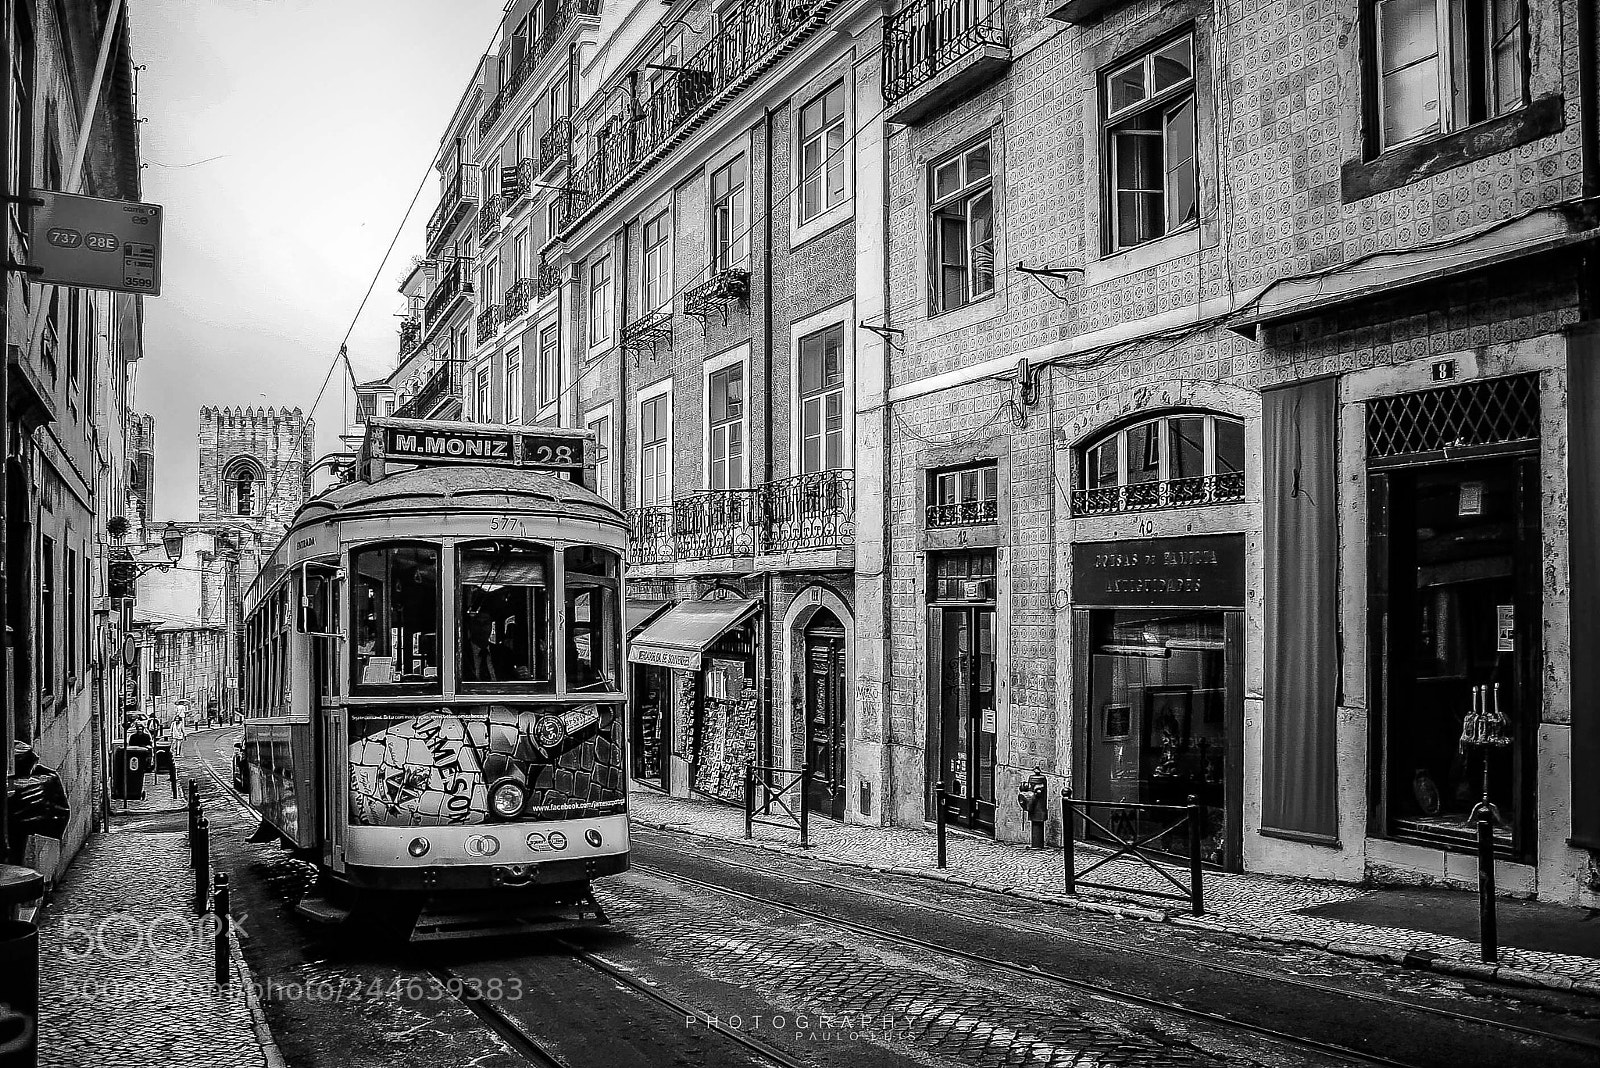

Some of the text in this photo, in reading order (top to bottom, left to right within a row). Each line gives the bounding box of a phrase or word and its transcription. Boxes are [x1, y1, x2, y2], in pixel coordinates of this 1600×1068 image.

[52, 232, 78, 245] 737
[88, 236, 115, 249] 28E
[125, 276, 152, 288] 3599
[1439, 363, 1447, 379] 8
[396, 434, 508, 457] M.MONIZ
[537, 445, 572, 464] 28
[490, 517, 518, 531] 577
